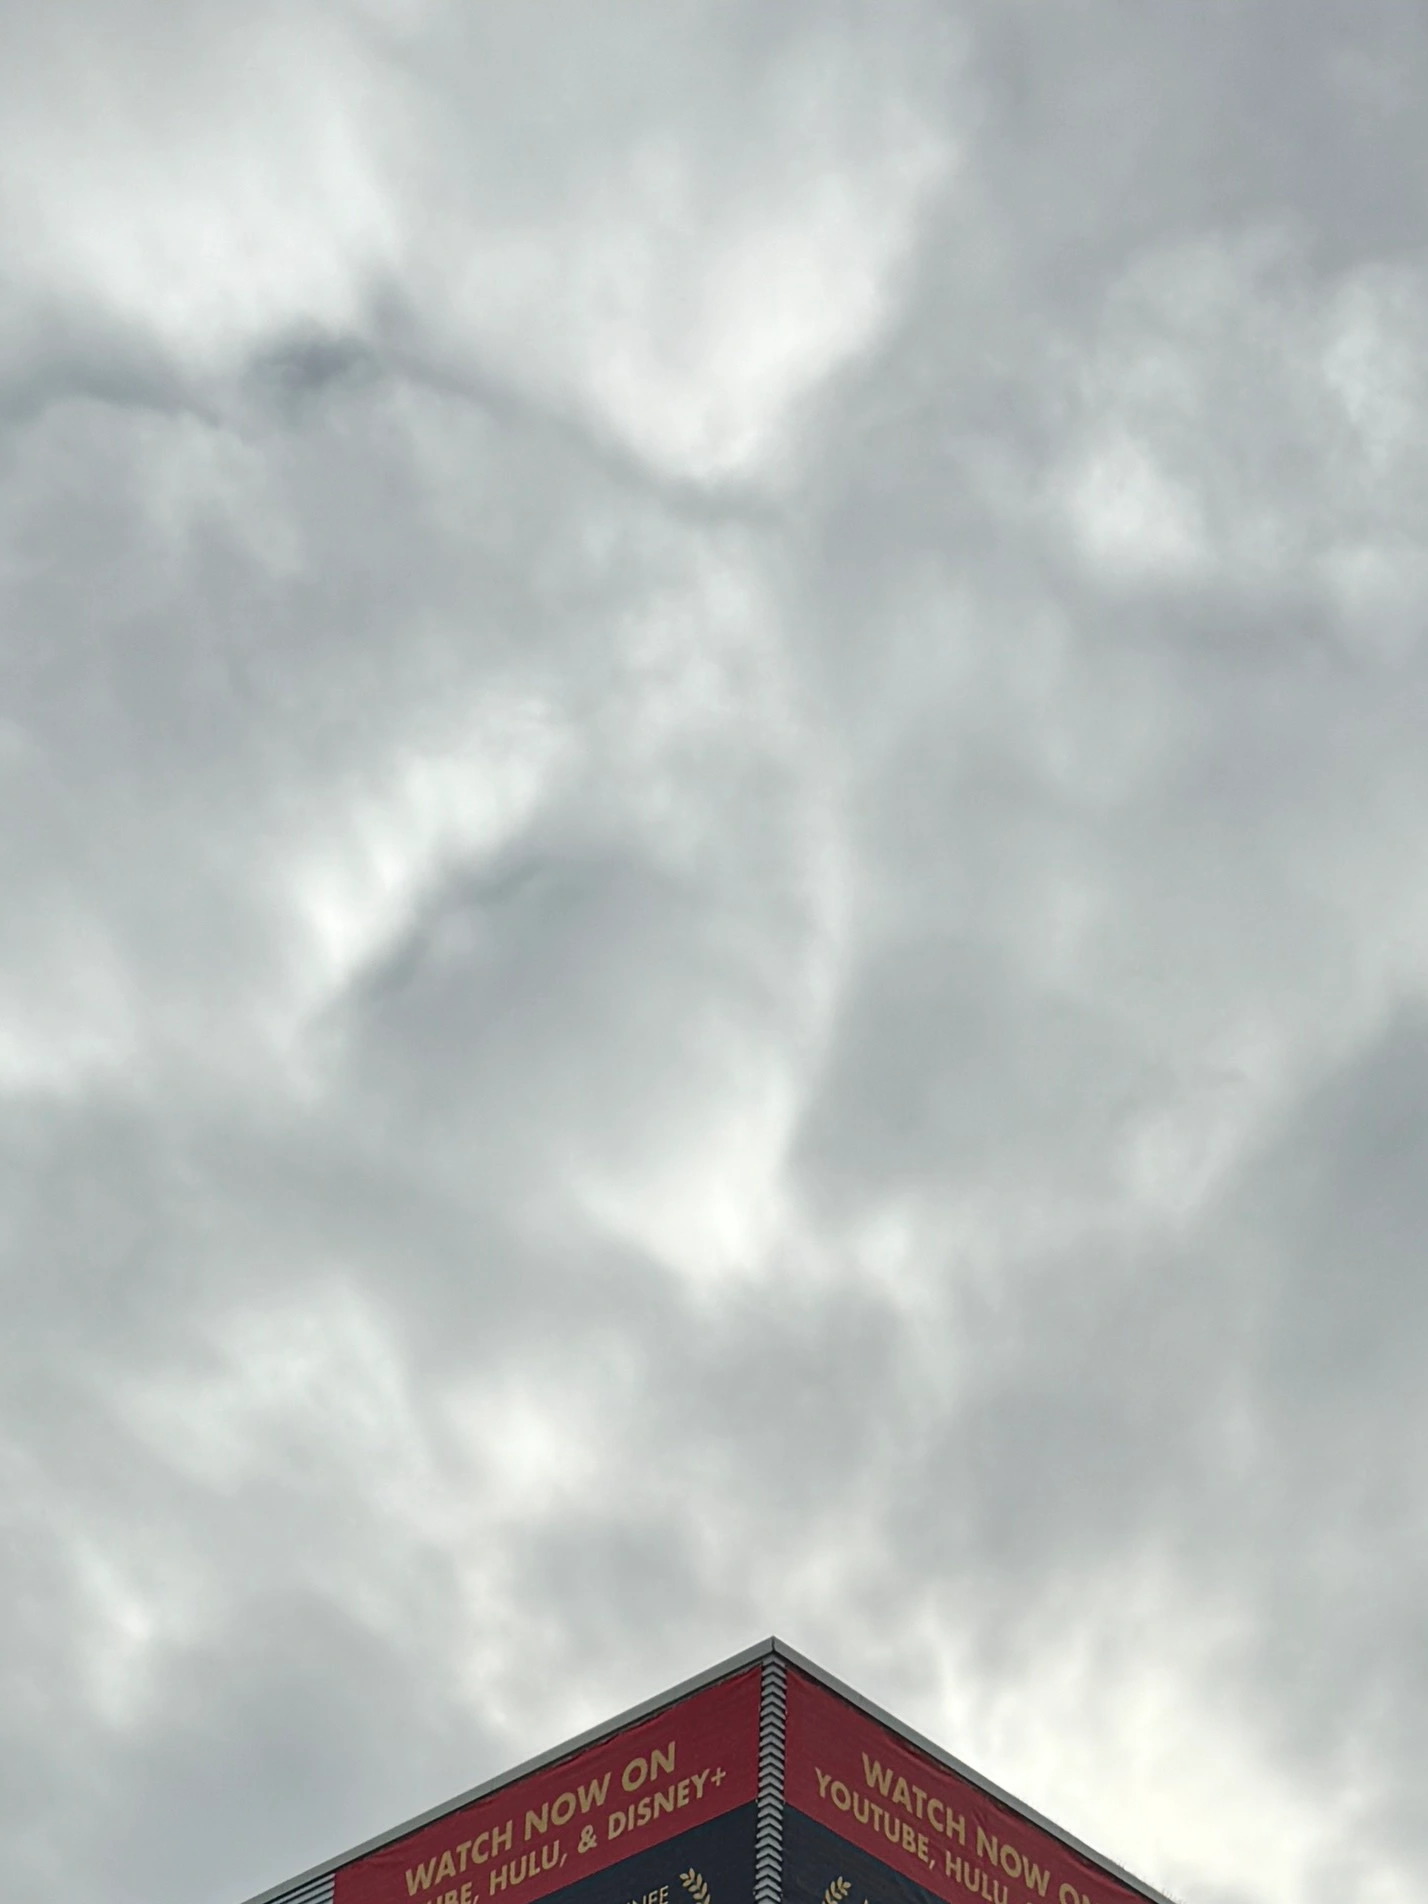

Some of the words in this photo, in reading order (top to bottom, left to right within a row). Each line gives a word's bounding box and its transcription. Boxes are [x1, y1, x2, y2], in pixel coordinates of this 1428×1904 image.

[405, 1821, 513, 1896] WATCH
[523, 1772, 612, 1841] NOW
[621, 1742, 676, 1791] ON
[489, 1840, 566, 1895] HULU,
[577, 1825, 597, 1854] &
[607, 1767, 726, 1840] DISNEY+
[814, 1767, 936, 1870] YOUTUBE,
[861, 1751, 966, 1846] WATCH
[976, 1826, 1051, 1897] NOW
